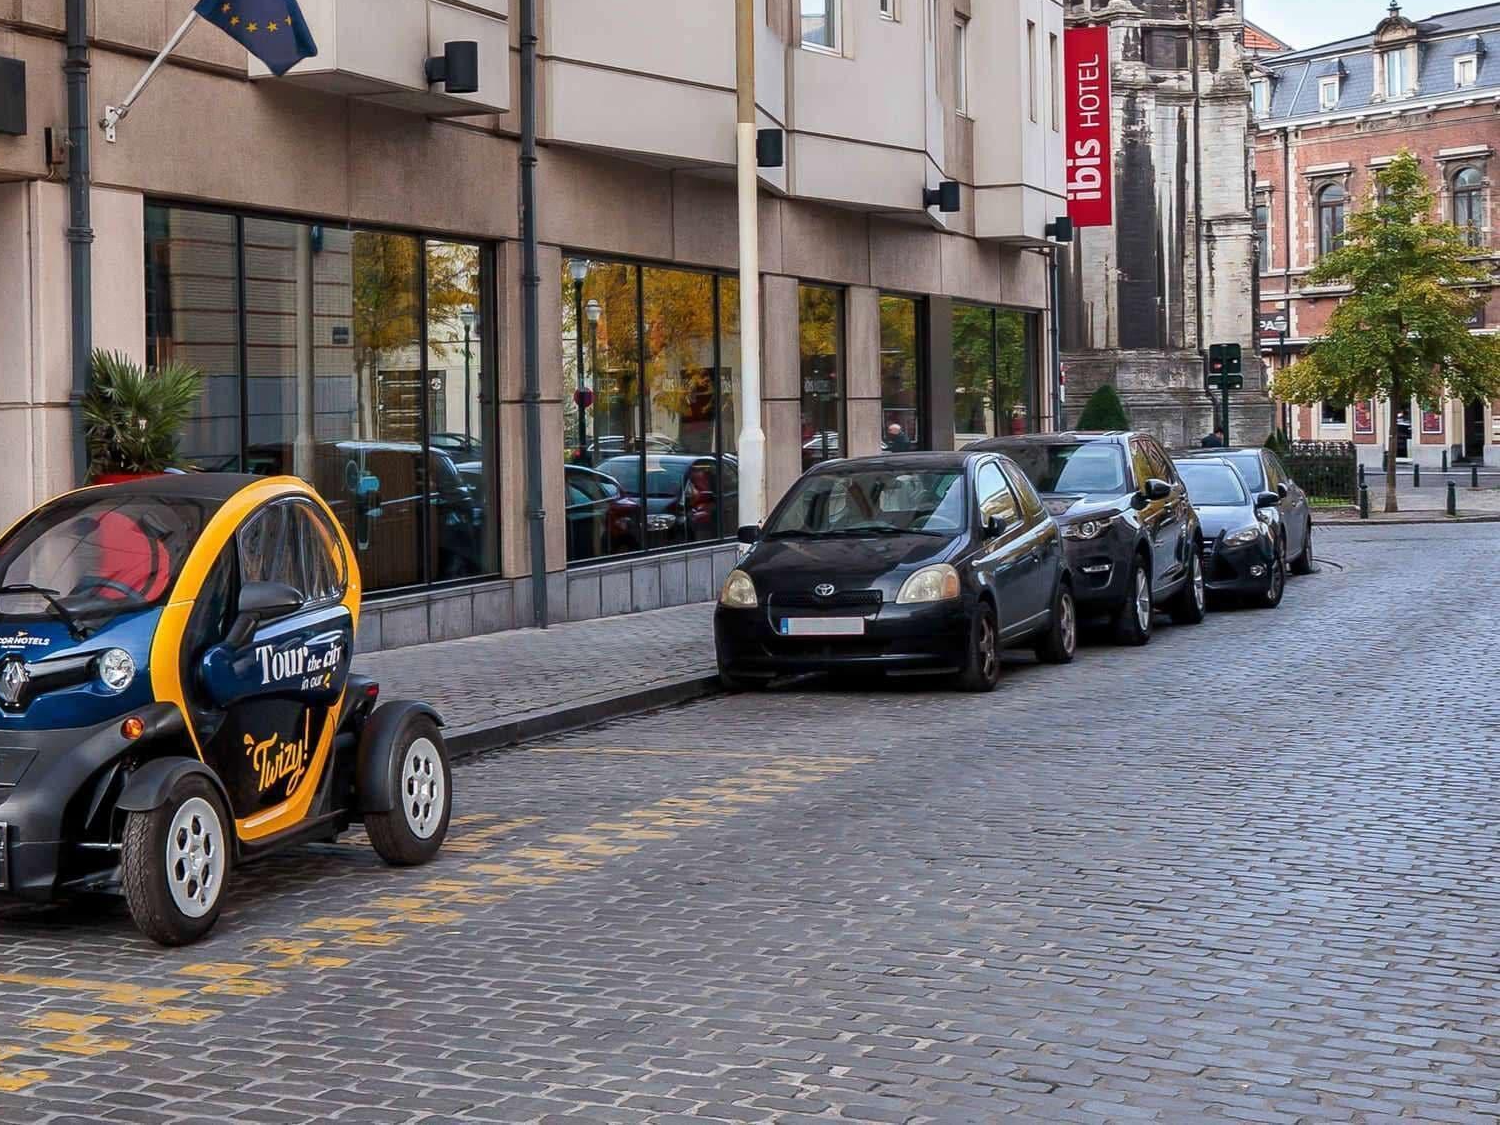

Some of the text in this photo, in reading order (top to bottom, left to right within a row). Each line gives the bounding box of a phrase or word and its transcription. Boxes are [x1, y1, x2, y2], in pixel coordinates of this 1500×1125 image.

[1067, 54, 1101, 200] ibis HOTEL
[255, 642, 343, 685] Tour the city
[301, 674, 323, 691] in our
[253, 708, 310, 796] Twizy!
